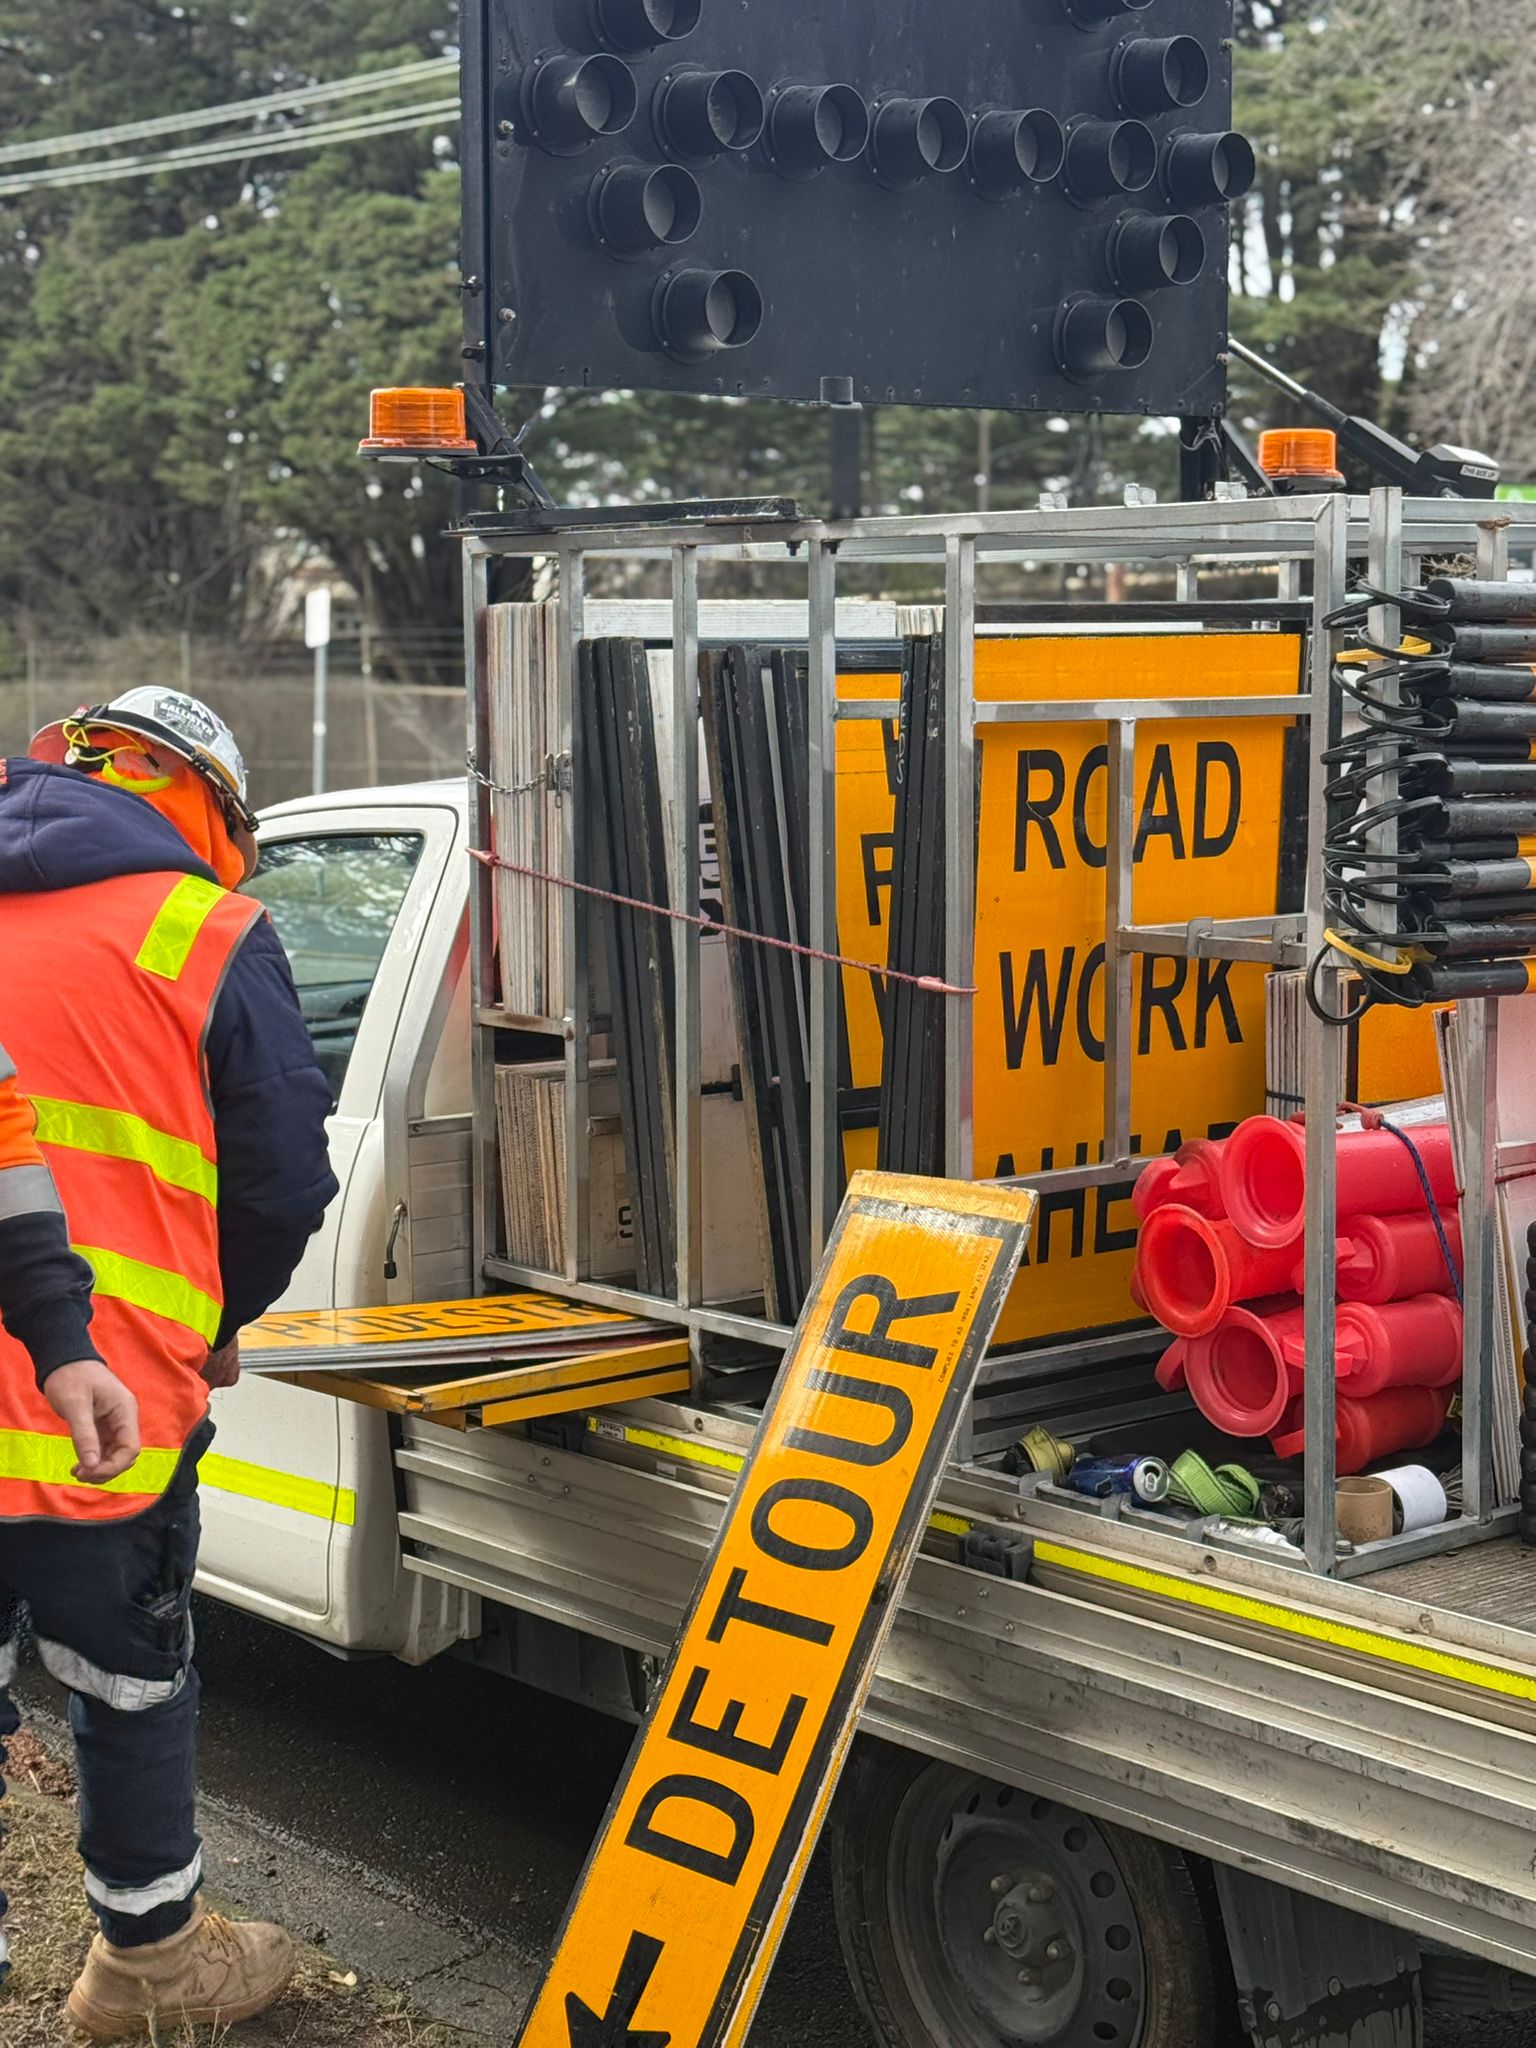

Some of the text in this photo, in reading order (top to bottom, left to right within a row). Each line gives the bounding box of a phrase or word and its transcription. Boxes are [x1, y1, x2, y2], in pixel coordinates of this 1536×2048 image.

[1013, 740, 1241, 873] ROAD
[998, 942, 1244, 1070] WORK
[623, 1273, 962, 1887] DETOUR
